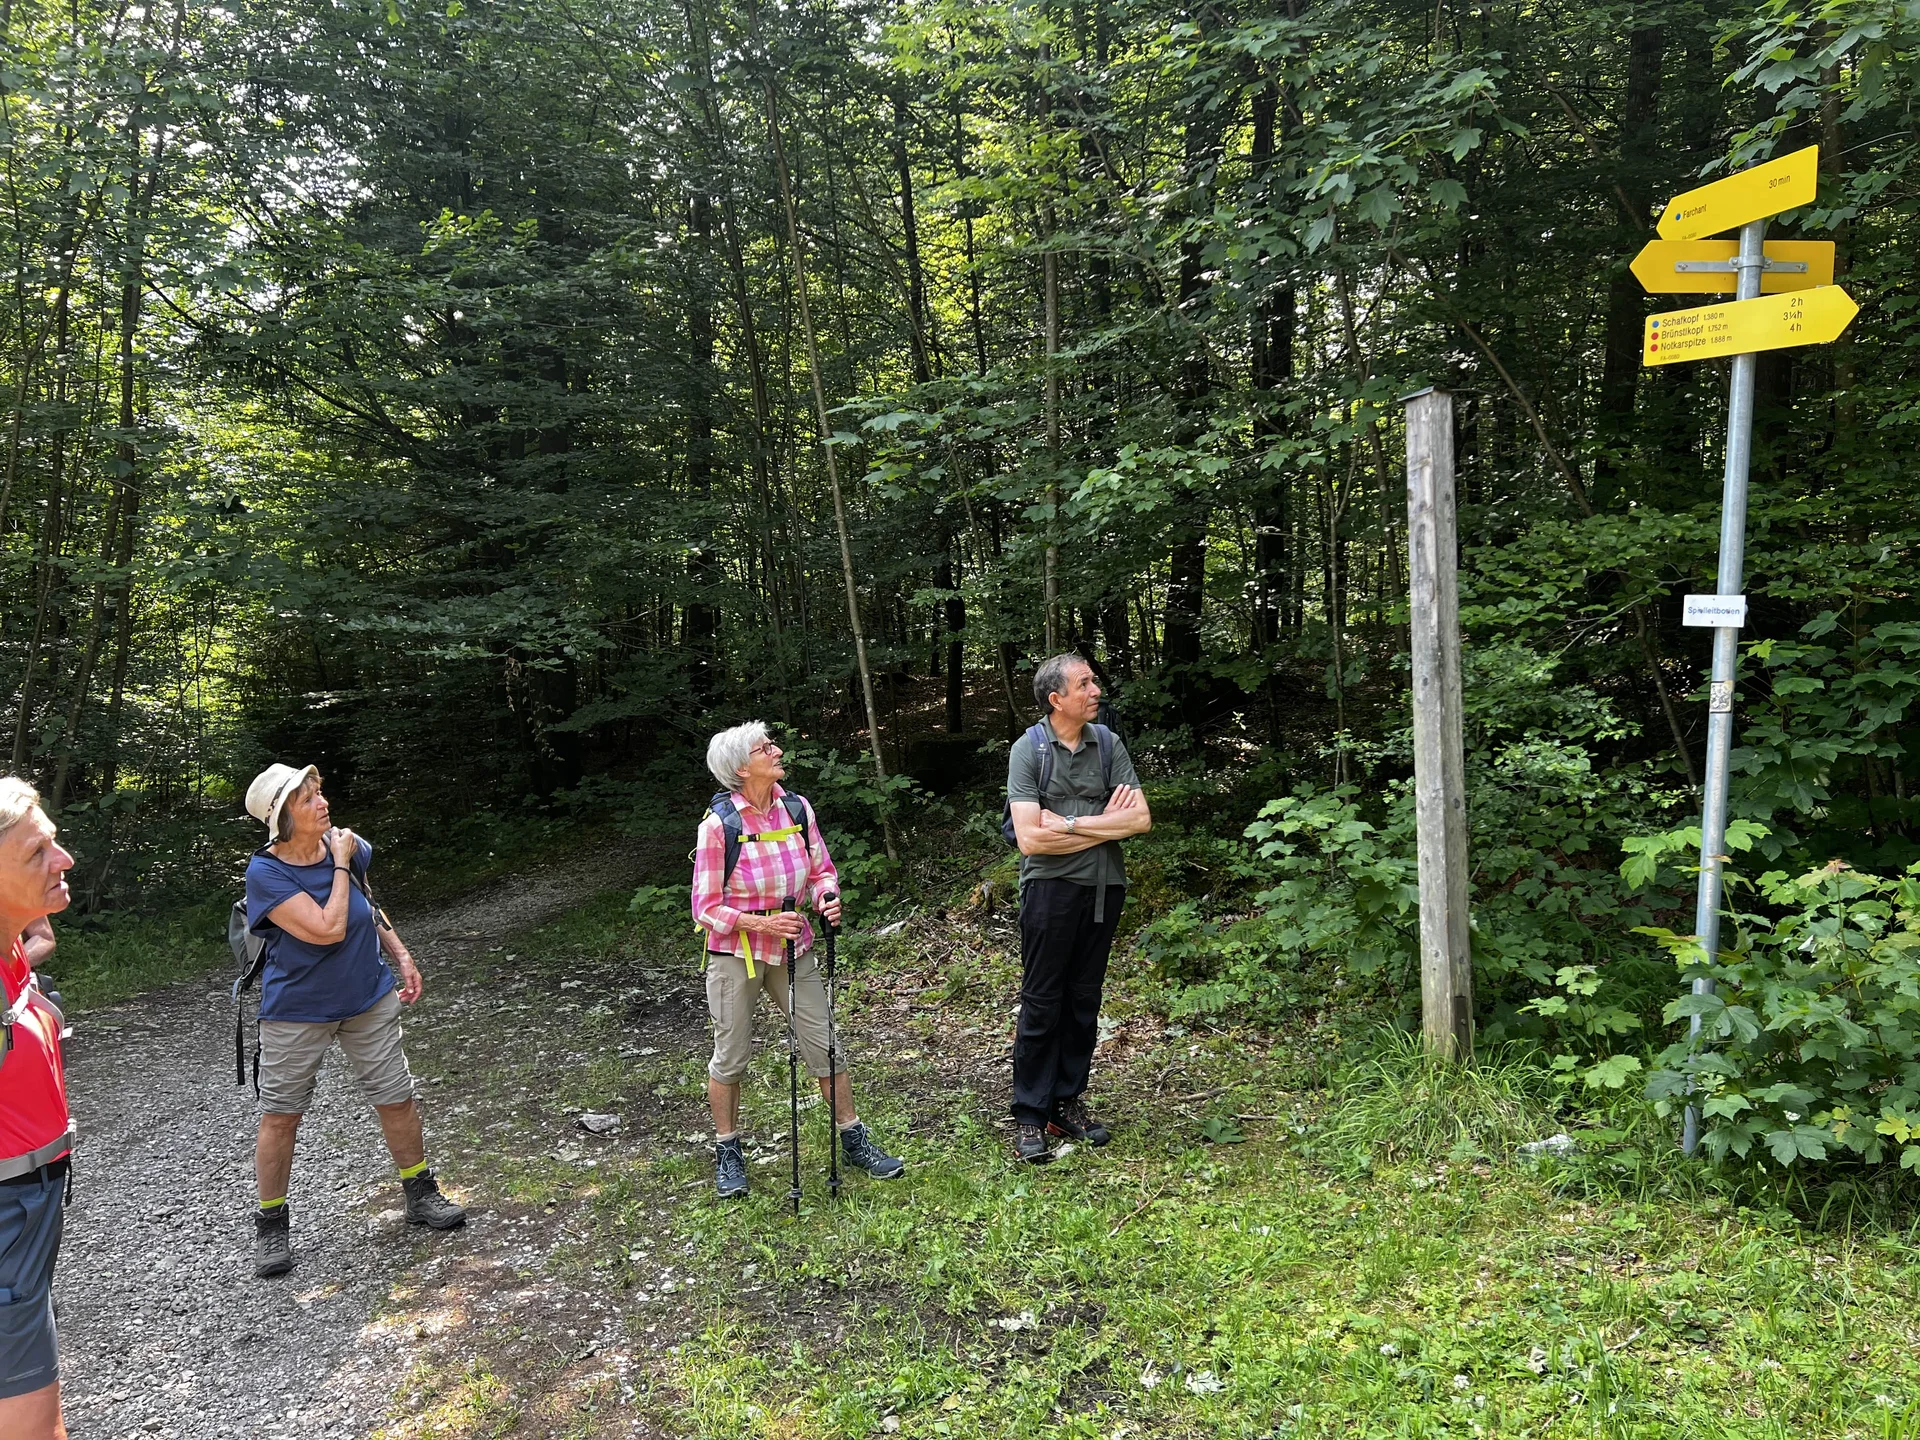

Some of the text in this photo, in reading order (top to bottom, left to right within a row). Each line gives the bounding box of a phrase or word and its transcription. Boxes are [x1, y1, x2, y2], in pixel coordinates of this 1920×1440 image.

[1768, 174, 1791, 189] 30 min
[1683, 204, 1707, 219] Farchant
[1791, 297, 1803, 307] 2 h
[1662, 313, 1699, 327] Schafkopf
[1703, 313, 1719, 321] 1.380
[1708, 324, 1721, 333] 1.752
[1790, 323, 1801, 332] 4 h
[1660, 337, 1706, 351] Notkarspitze
